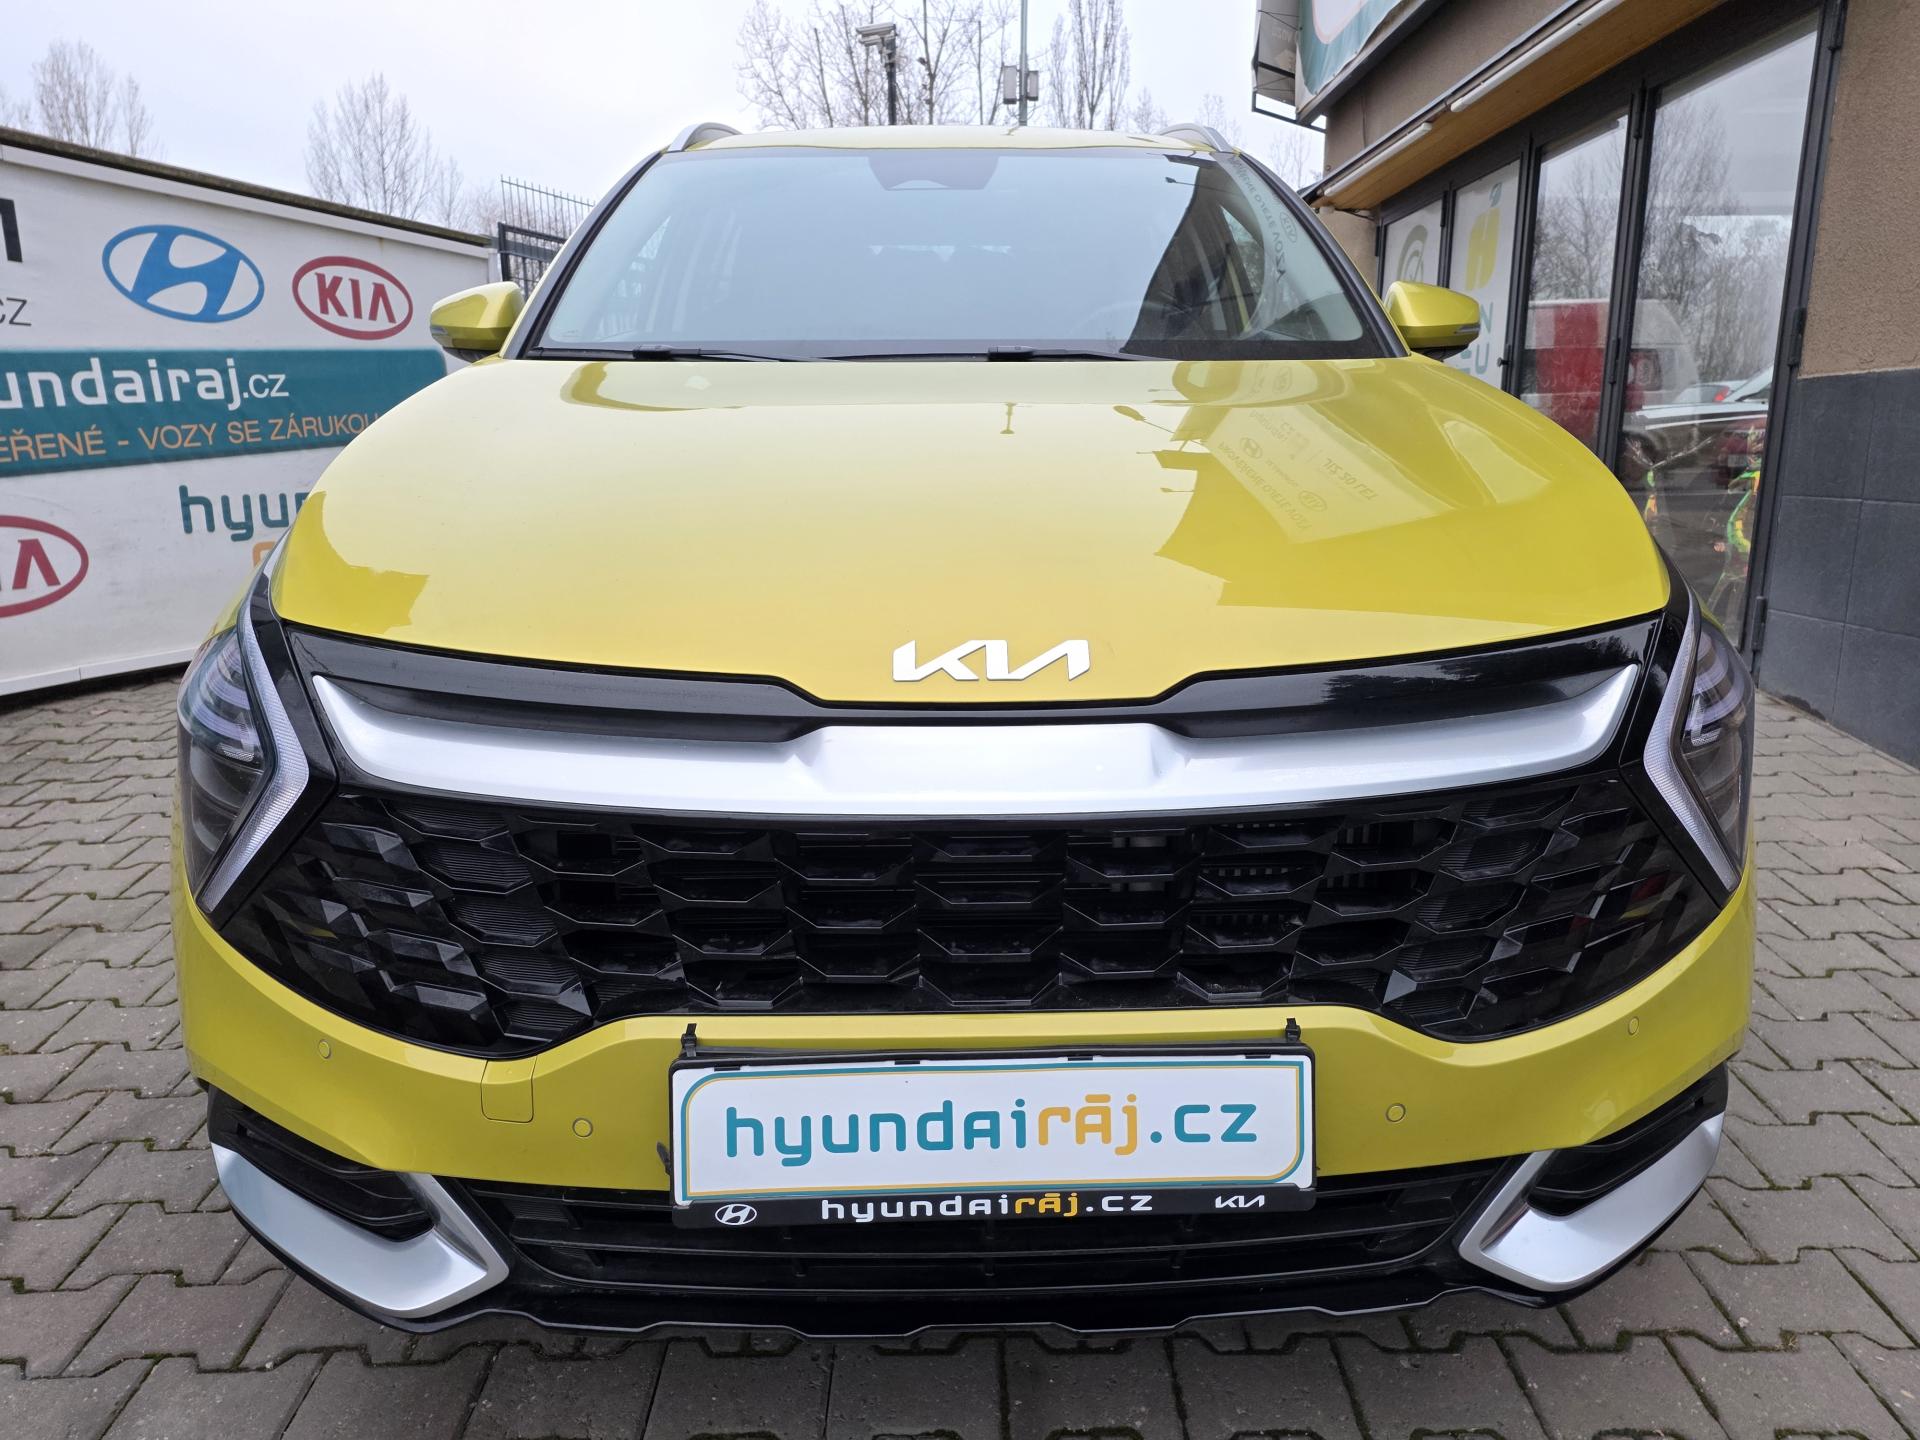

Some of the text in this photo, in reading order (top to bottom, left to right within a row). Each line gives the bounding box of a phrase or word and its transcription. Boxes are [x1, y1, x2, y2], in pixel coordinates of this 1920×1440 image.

[314, 272, 397, 324] KIA
[138, 422, 217, 450] VOZY
[227, 420, 261, 444] SE
[892, 640, 1090, 682] KIA
[1215, 1195, 1265, 1209] KIA
